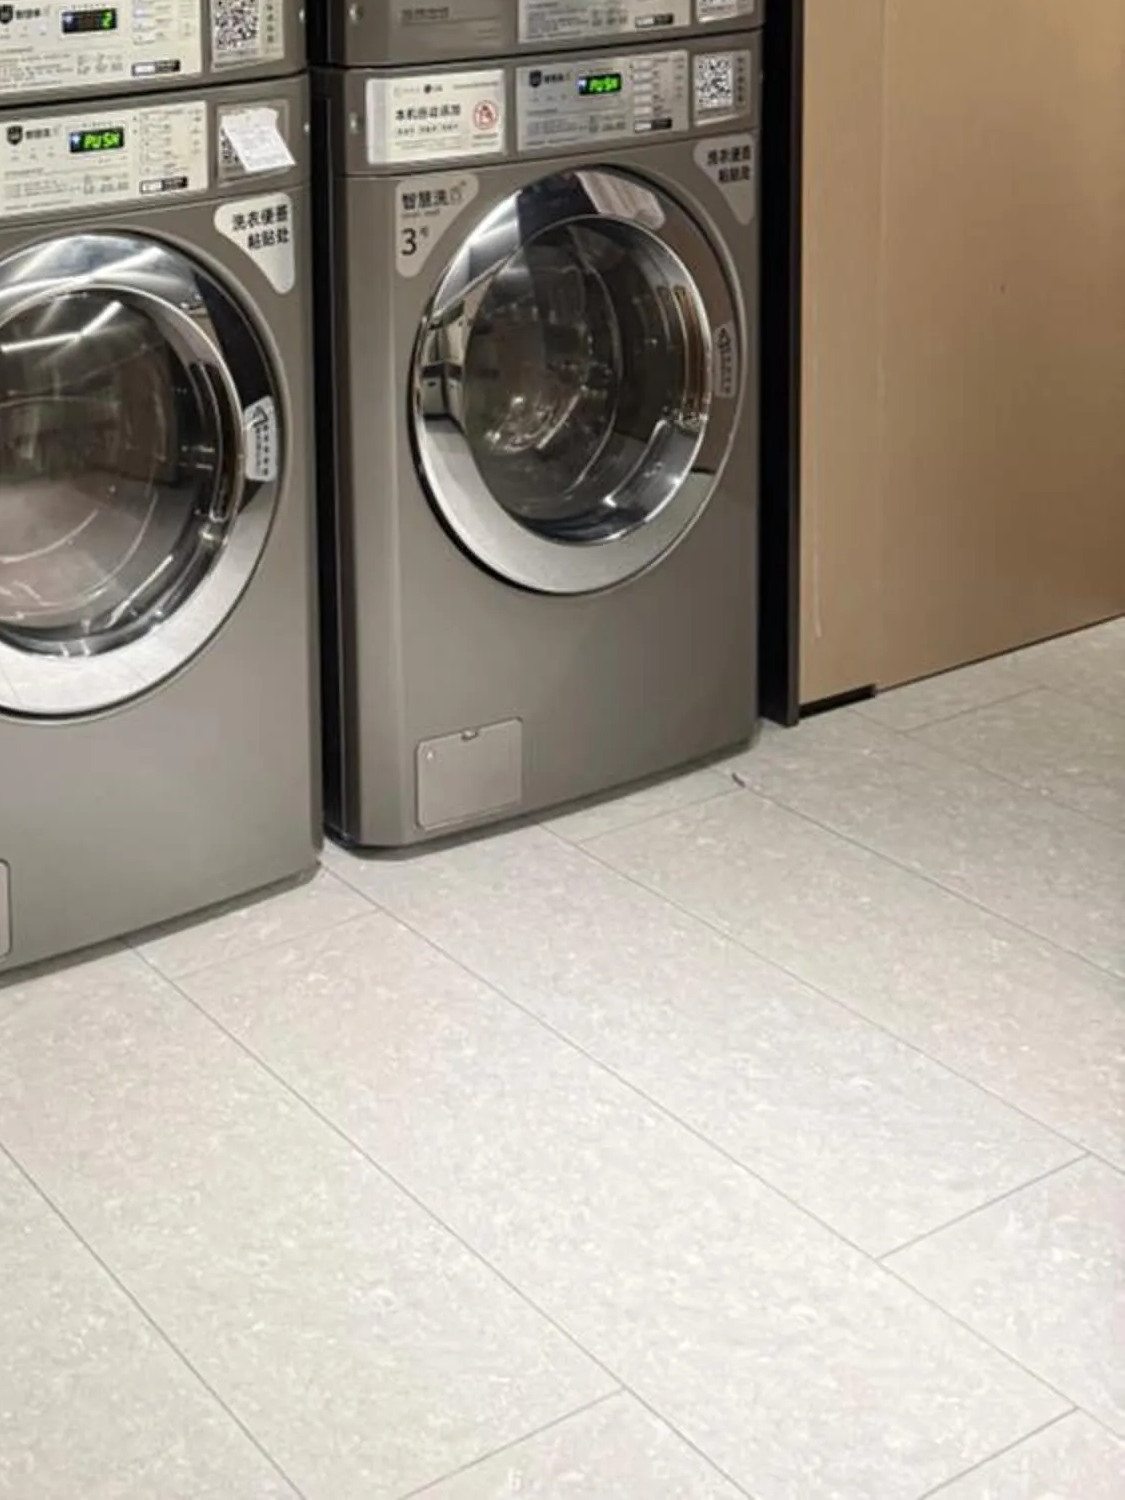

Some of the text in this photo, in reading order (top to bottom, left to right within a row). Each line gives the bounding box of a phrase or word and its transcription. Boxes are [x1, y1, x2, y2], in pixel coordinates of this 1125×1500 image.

[589, 77, 620, 93] PUSH
[83, 131, 121, 148] PUSH
[248, 226, 289, 250] 粘贴处
